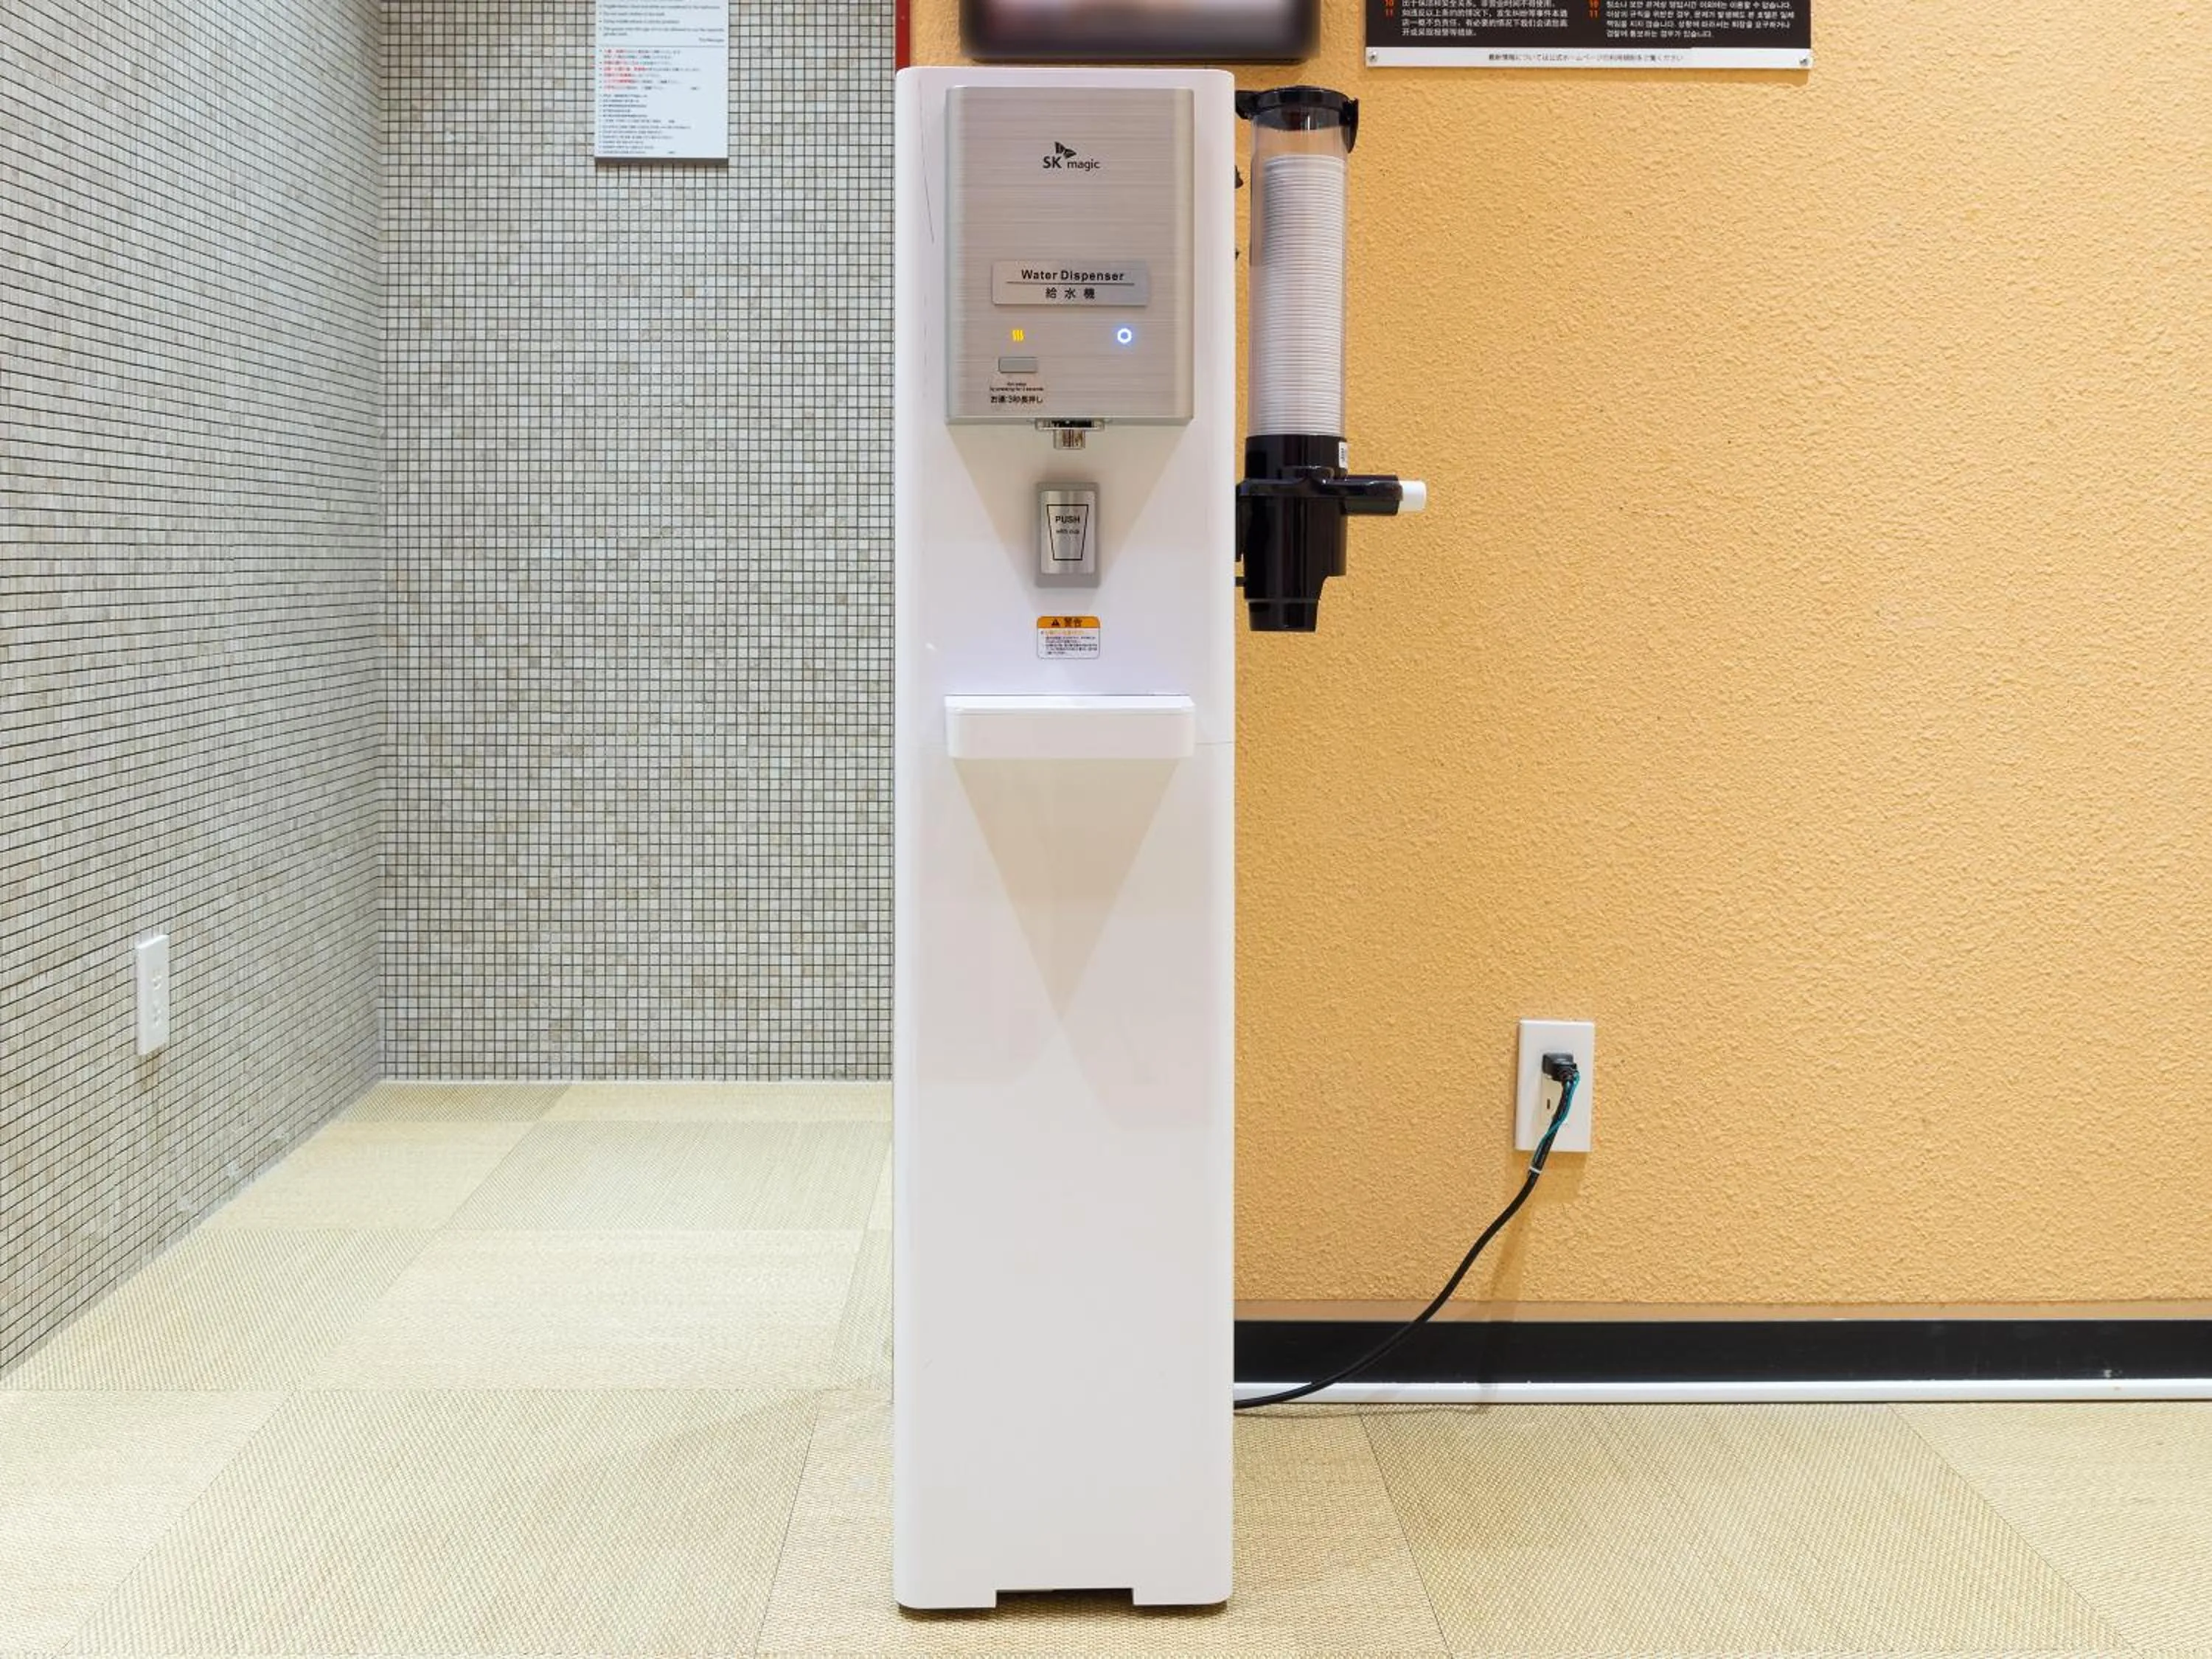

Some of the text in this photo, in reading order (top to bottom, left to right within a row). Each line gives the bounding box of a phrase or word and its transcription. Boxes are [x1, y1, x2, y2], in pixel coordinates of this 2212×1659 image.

[1043, 156, 1101, 172] SK magic
[1021, 269, 1124, 282] Water Dispenser
[1055, 515, 1080, 524] PUSH
[1063, 616, 1082, 627] 警告
